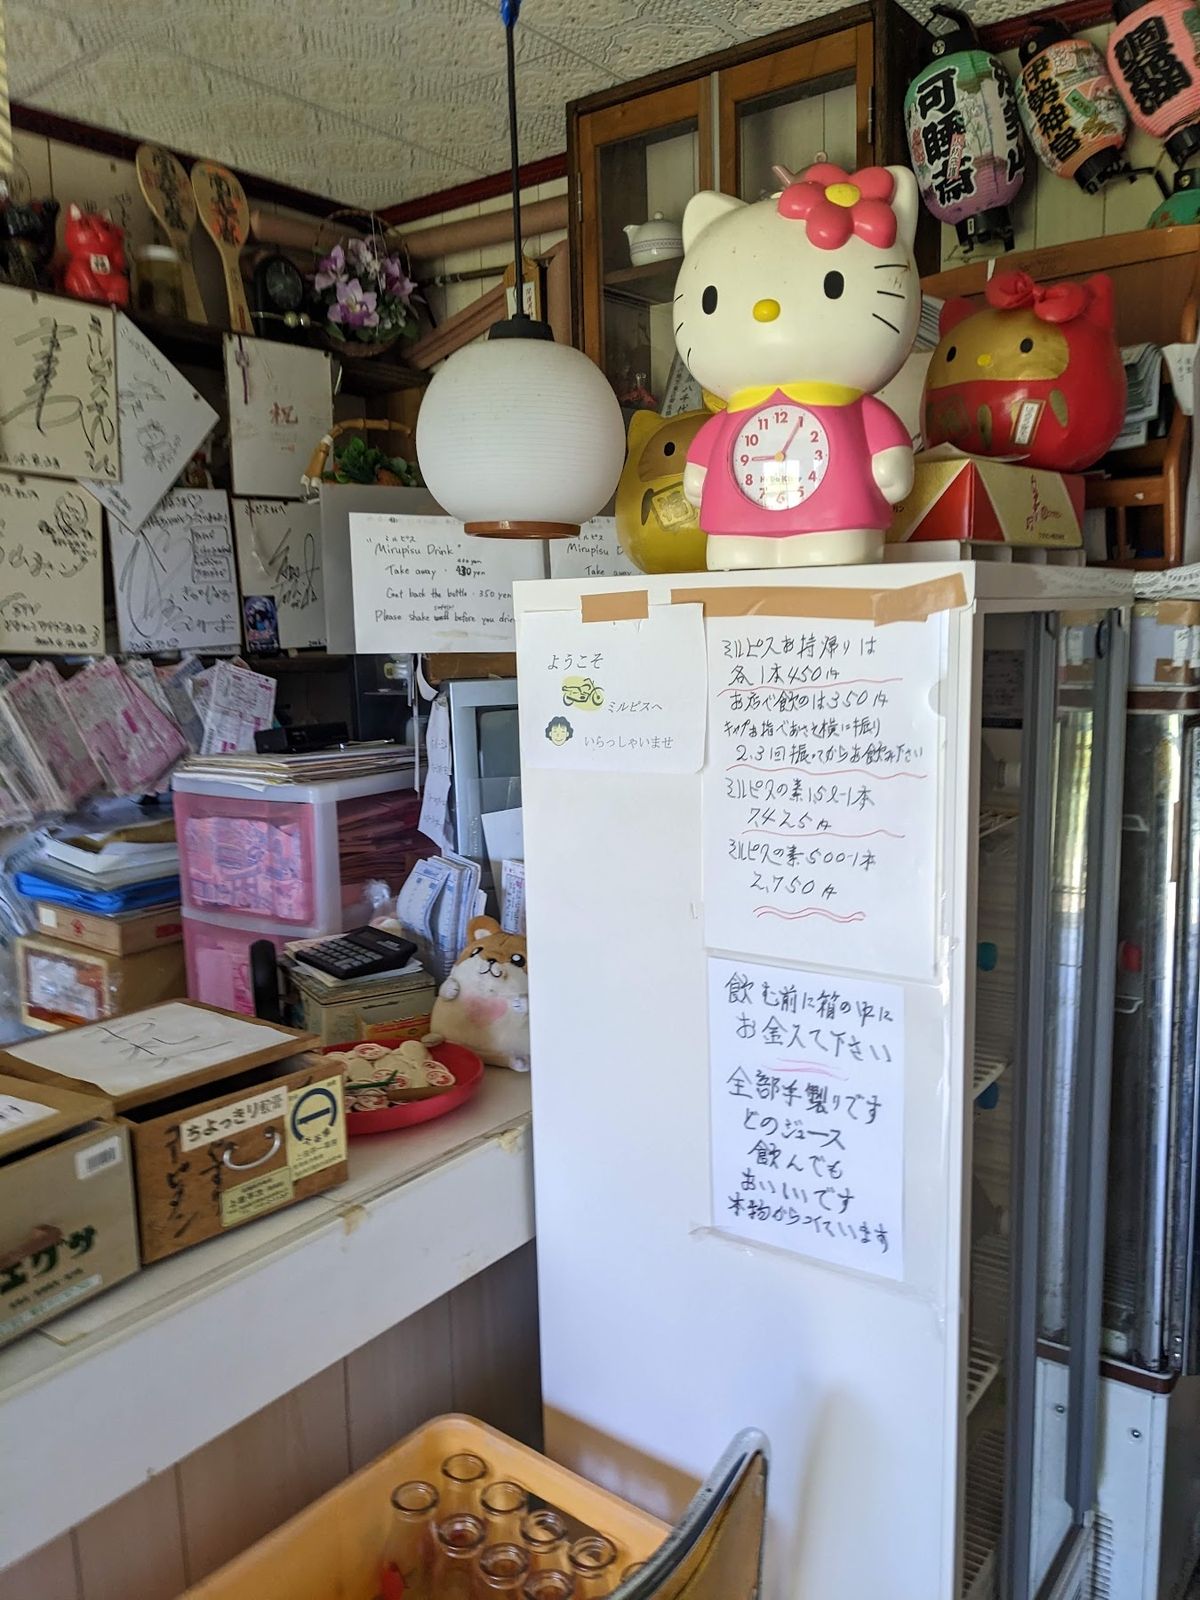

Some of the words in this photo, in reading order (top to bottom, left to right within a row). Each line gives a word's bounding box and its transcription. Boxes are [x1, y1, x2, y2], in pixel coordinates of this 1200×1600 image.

[775, 411, 788, 423] 12
[799, 416, 804, 428] 1
[758, 418, 769, 430] 11
[745, 434, 759, 446] 10
[810, 431, 819, 443] 2
[740, 454, 749, 466] 9
[814, 450, 823, 461] 3
[745, 474, 753, 486] 8
[808, 470, 817, 482] 4
[759, 488, 765, 499] 7
[797, 486, 804, 497] 5
[776, 492, 785, 504] 6
[567, 543, 609, 557] Mirupisu
[385, 565, 410, 576] Take
[415, 568, 437, 578] away
[472, 569, 486, 578] yen
[585, 566, 606, 576] Take
[408, 588, 427, 599] back
[430, 588, 442, 599] the
[446, 588, 468, 599] bottle
[479, 589, 495, 599] 350
[497, 591, 512, 600] yen
[375, 610, 402, 622] Please
[409, 611, 430, 622] shake
[454, 612, 476, 624] before
[481, 616, 496, 626] you
[547, 652, 604, 671] ようこそ
[607, 701, 663, 713] ミルピスへ
[584, 735, 674, 749] いらっしゃいませ
[725, 971, 893, 1027] 飲む前に箱の中に
[736, 1012, 892, 1062] お金入て下さい
[747, 1139, 843, 1179] 飲んでも
